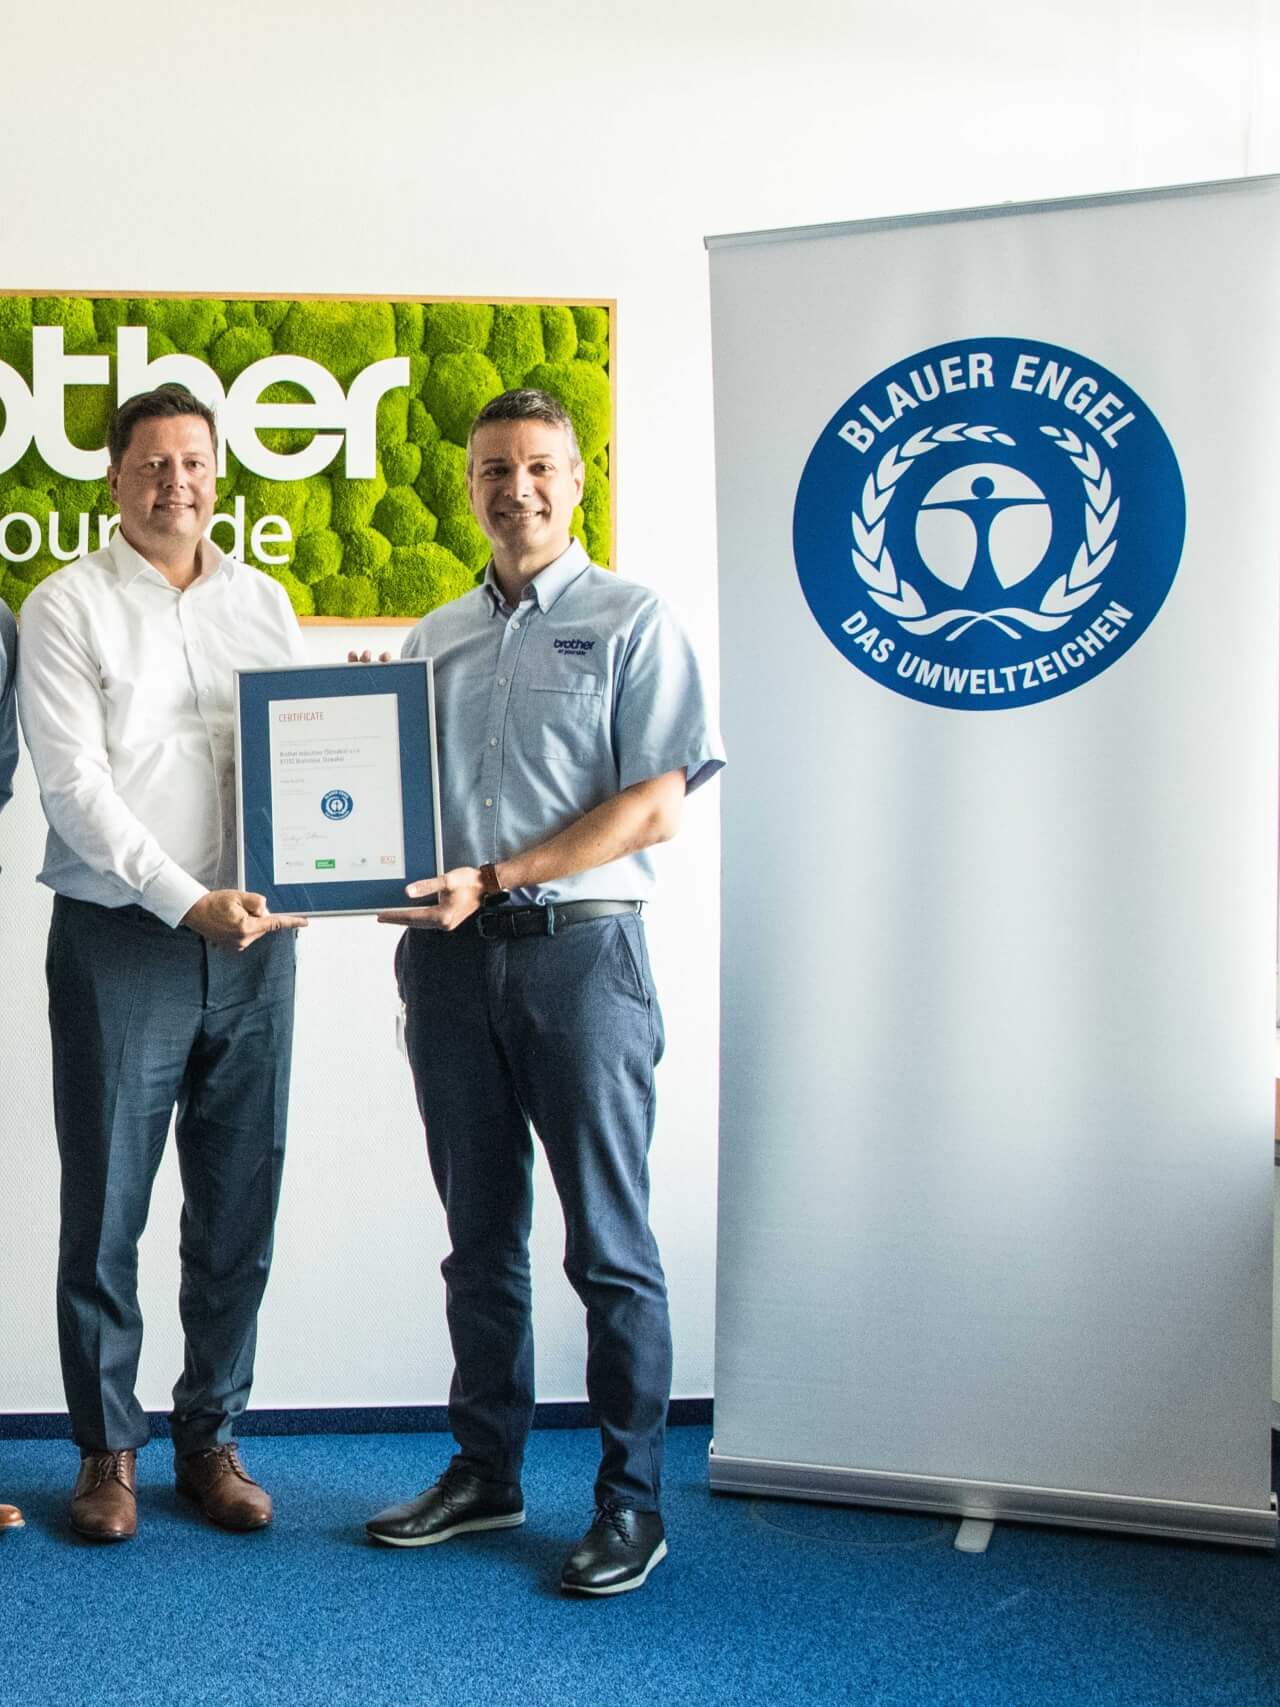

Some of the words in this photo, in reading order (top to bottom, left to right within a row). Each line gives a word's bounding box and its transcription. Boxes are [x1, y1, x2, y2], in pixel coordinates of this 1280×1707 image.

[838, 352, 995, 454] BLAUER
[1010, 353, 1136, 449] ENGEL
[202, 495, 293, 565] de
[553, 638, 595, 650] brother
[841, 610, 896, 664] DAS
[896, 600, 1134, 695] UMWELTZEICHEN
[278, 711, 325, 722] CERTIFICATE
